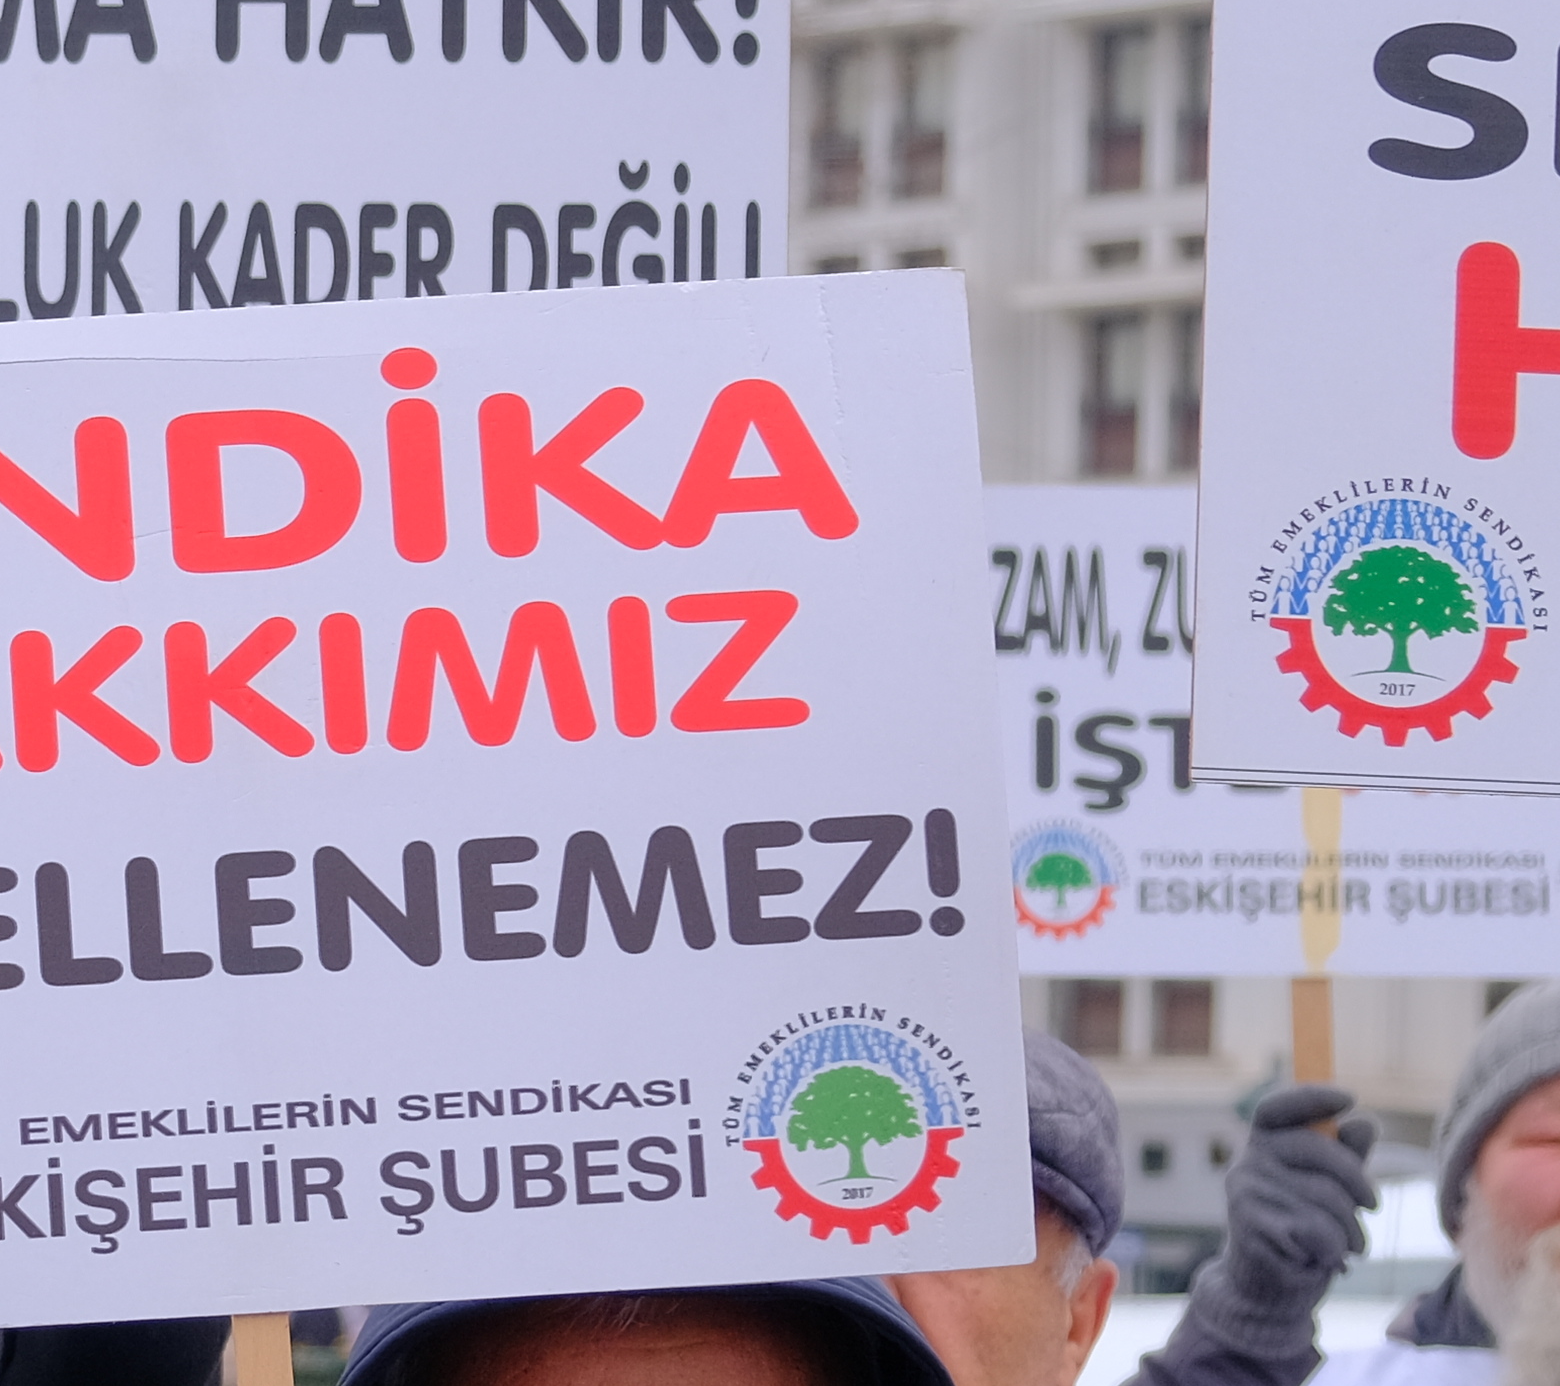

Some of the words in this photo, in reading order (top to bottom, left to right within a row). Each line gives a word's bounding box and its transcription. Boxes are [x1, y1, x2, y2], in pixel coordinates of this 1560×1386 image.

[177, 199, 455, 310] KADER
[992, 548, 1120, 675] ZAM,
[1249, 565, 1275, 622] TÜM
[1271, 477, 1451, 554] EMEKLİLERİN
[1463, 497, 1548, 632] SENDİKASI
[1379, 682, 1416, 697] 2017
[1035, 690, 1283, 811] İŞT
[1138, 873, 1371, 923] ESKİŞEHİR
[1387, 872, 1551, 924] ŞUBESİ
[18, 1091, 382, 1147] EMEKLİLERİN
[398, 1077, 691, 1124] SENDİKASI
[738, 1003, 887, 1085] EMEKLİLERİN
[897, 1017, 981, 1128] SENDİKASI
[379, 1116, 709, 1237] ŞUBESİ
